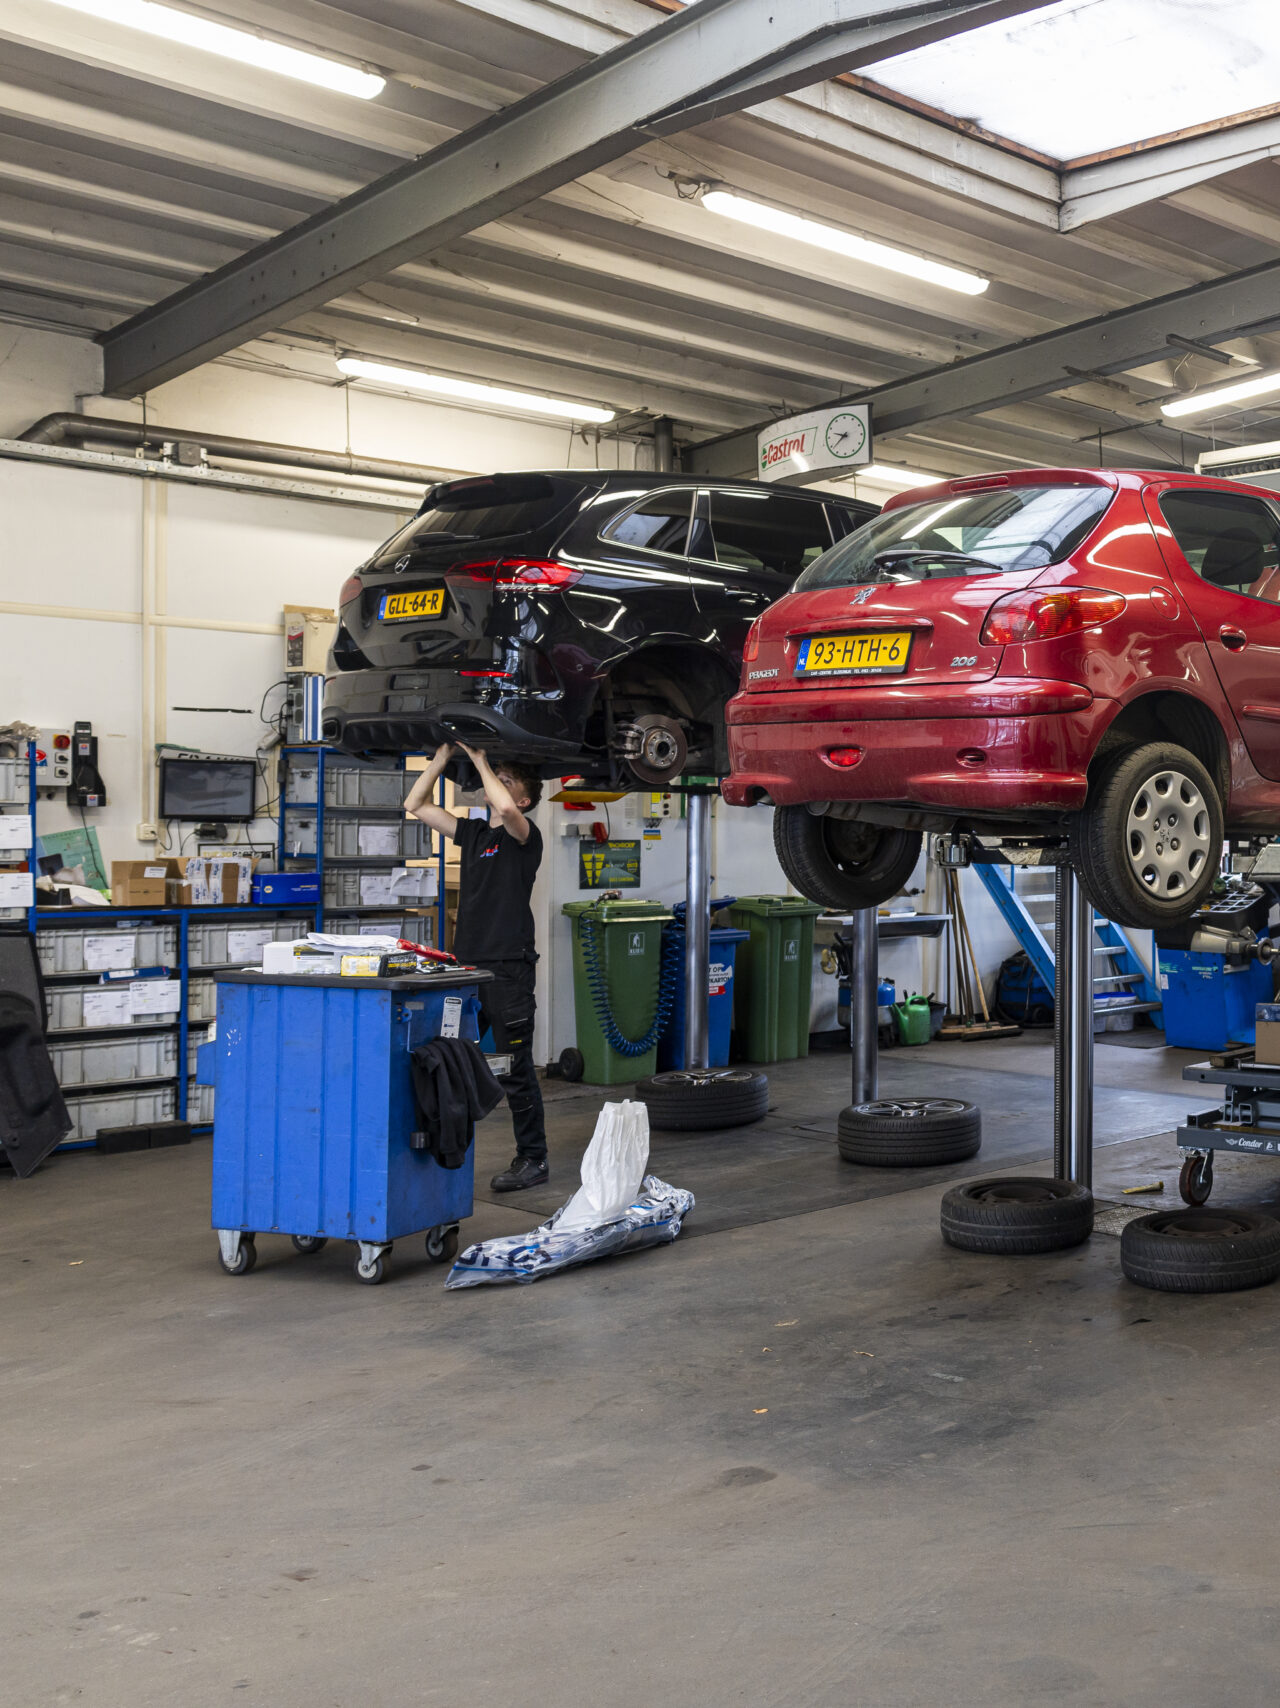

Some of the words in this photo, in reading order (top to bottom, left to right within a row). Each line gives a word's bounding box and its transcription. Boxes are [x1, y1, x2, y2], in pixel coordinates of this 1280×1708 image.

[388, 593, 439, 615] GLL-64-R
[814, 637, 901, 665] 93-HTH-6
[950, 655, 978, 667] 206
[748, 668, 780, 680] PEUGEOT
[1238, 1138, 1263, 1149] Condor
